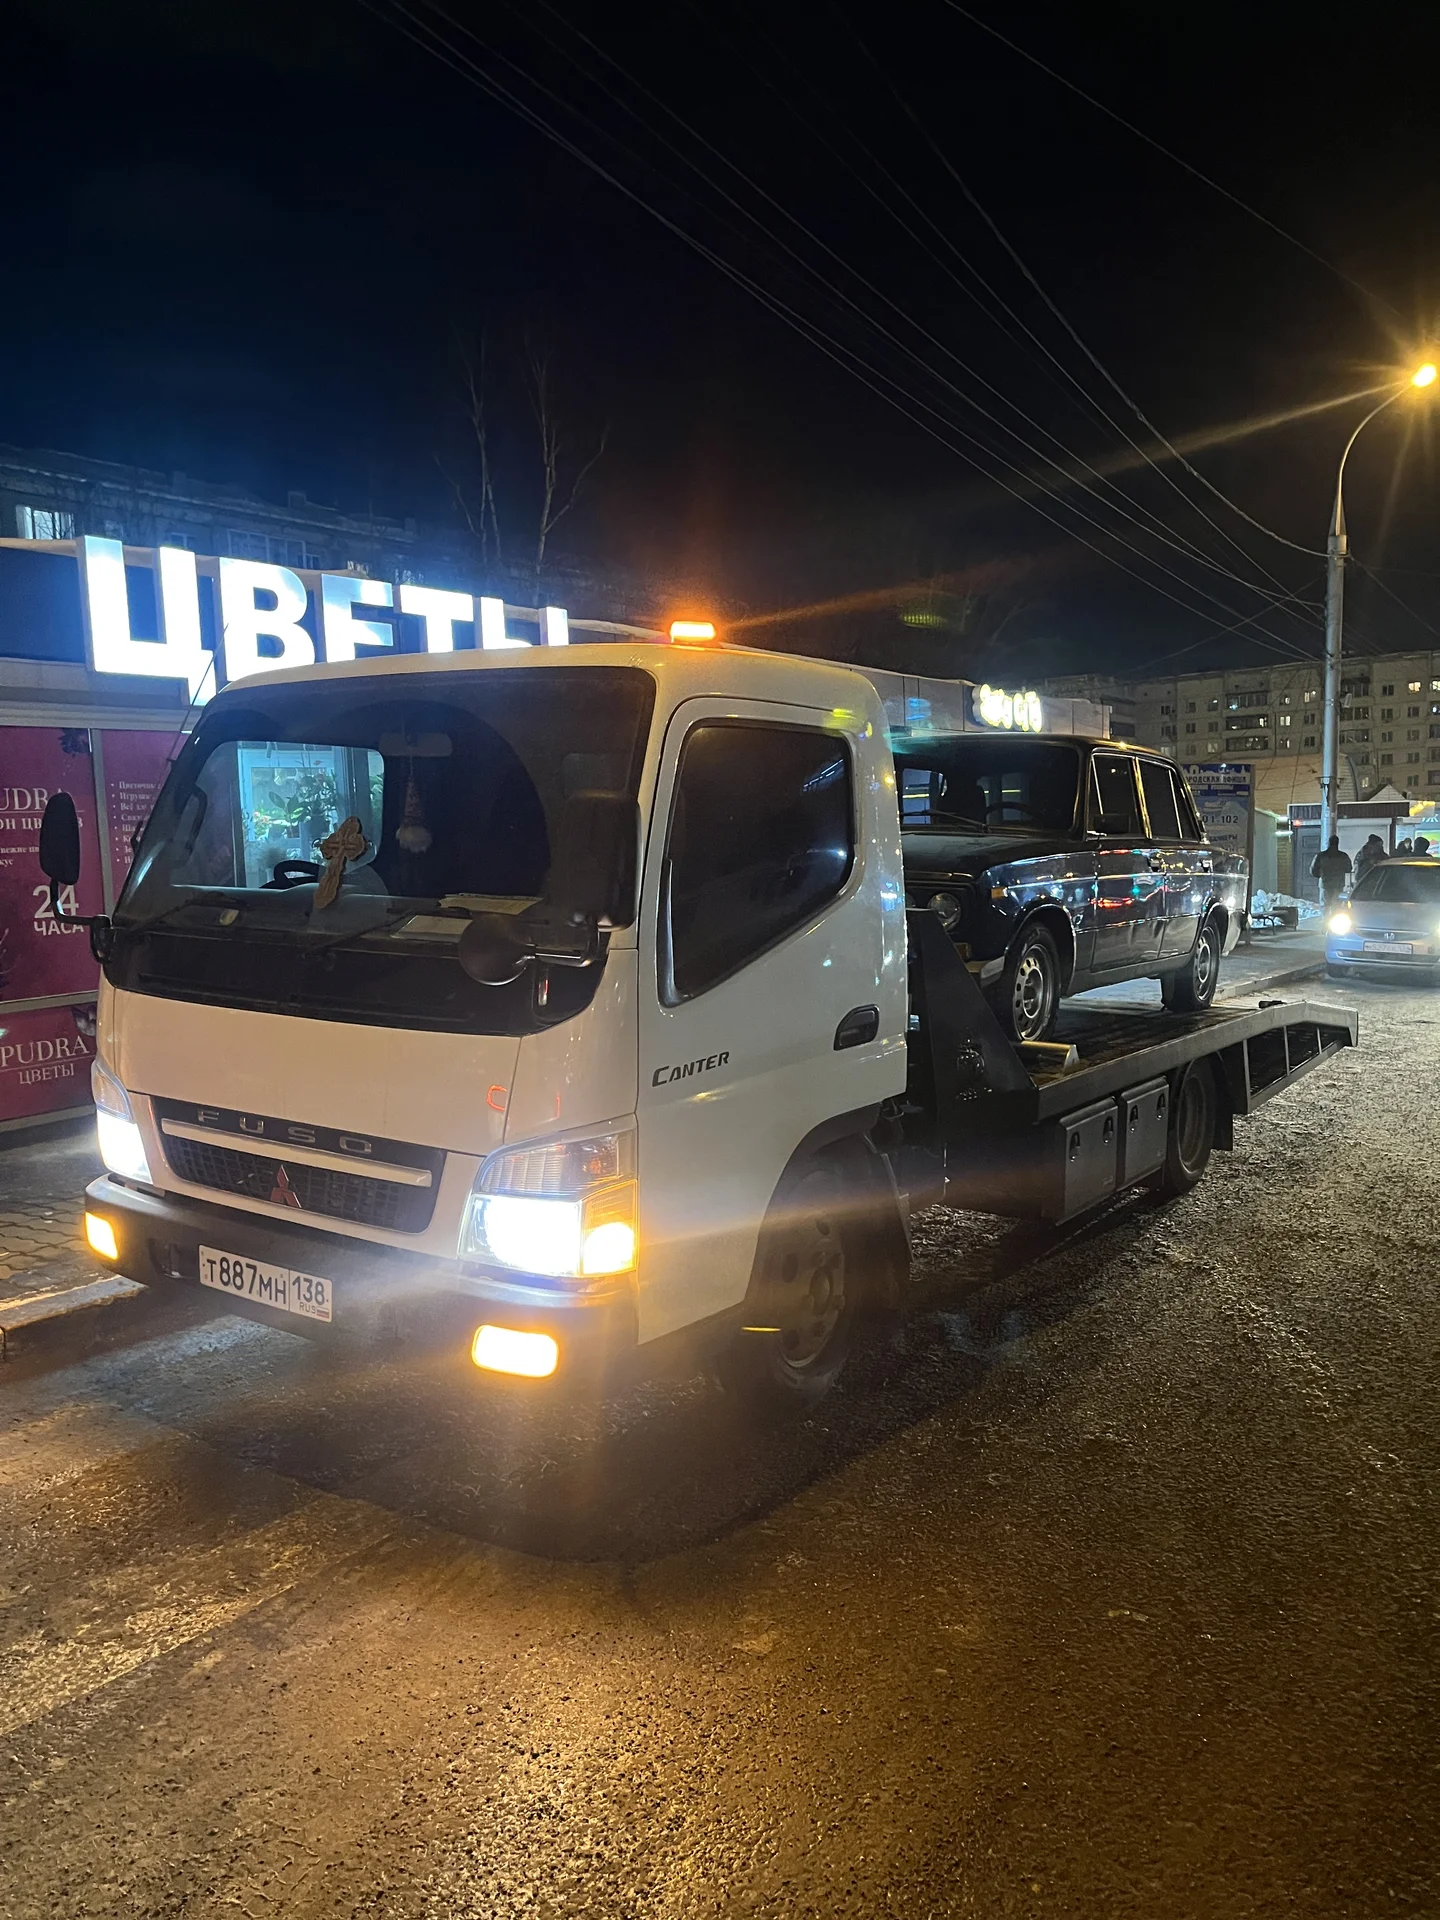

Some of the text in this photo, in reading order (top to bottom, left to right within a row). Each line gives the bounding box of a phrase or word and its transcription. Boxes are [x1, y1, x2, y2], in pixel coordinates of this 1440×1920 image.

[83, 535, 569, 706] ЦВЕТЫ
[33, 884, 79, 919] 24
[33, 919, 85, 936] ЧАСА
[0, 1034, 91, 1068] PUDRA
[19, 1063, 75, 1085] ЦВЕТЫ
[651, 1051, 730, 1088] CANTER
[197, 1108, 372, 1153] FUSO
[299, 1301, 317, 1315] RUS
